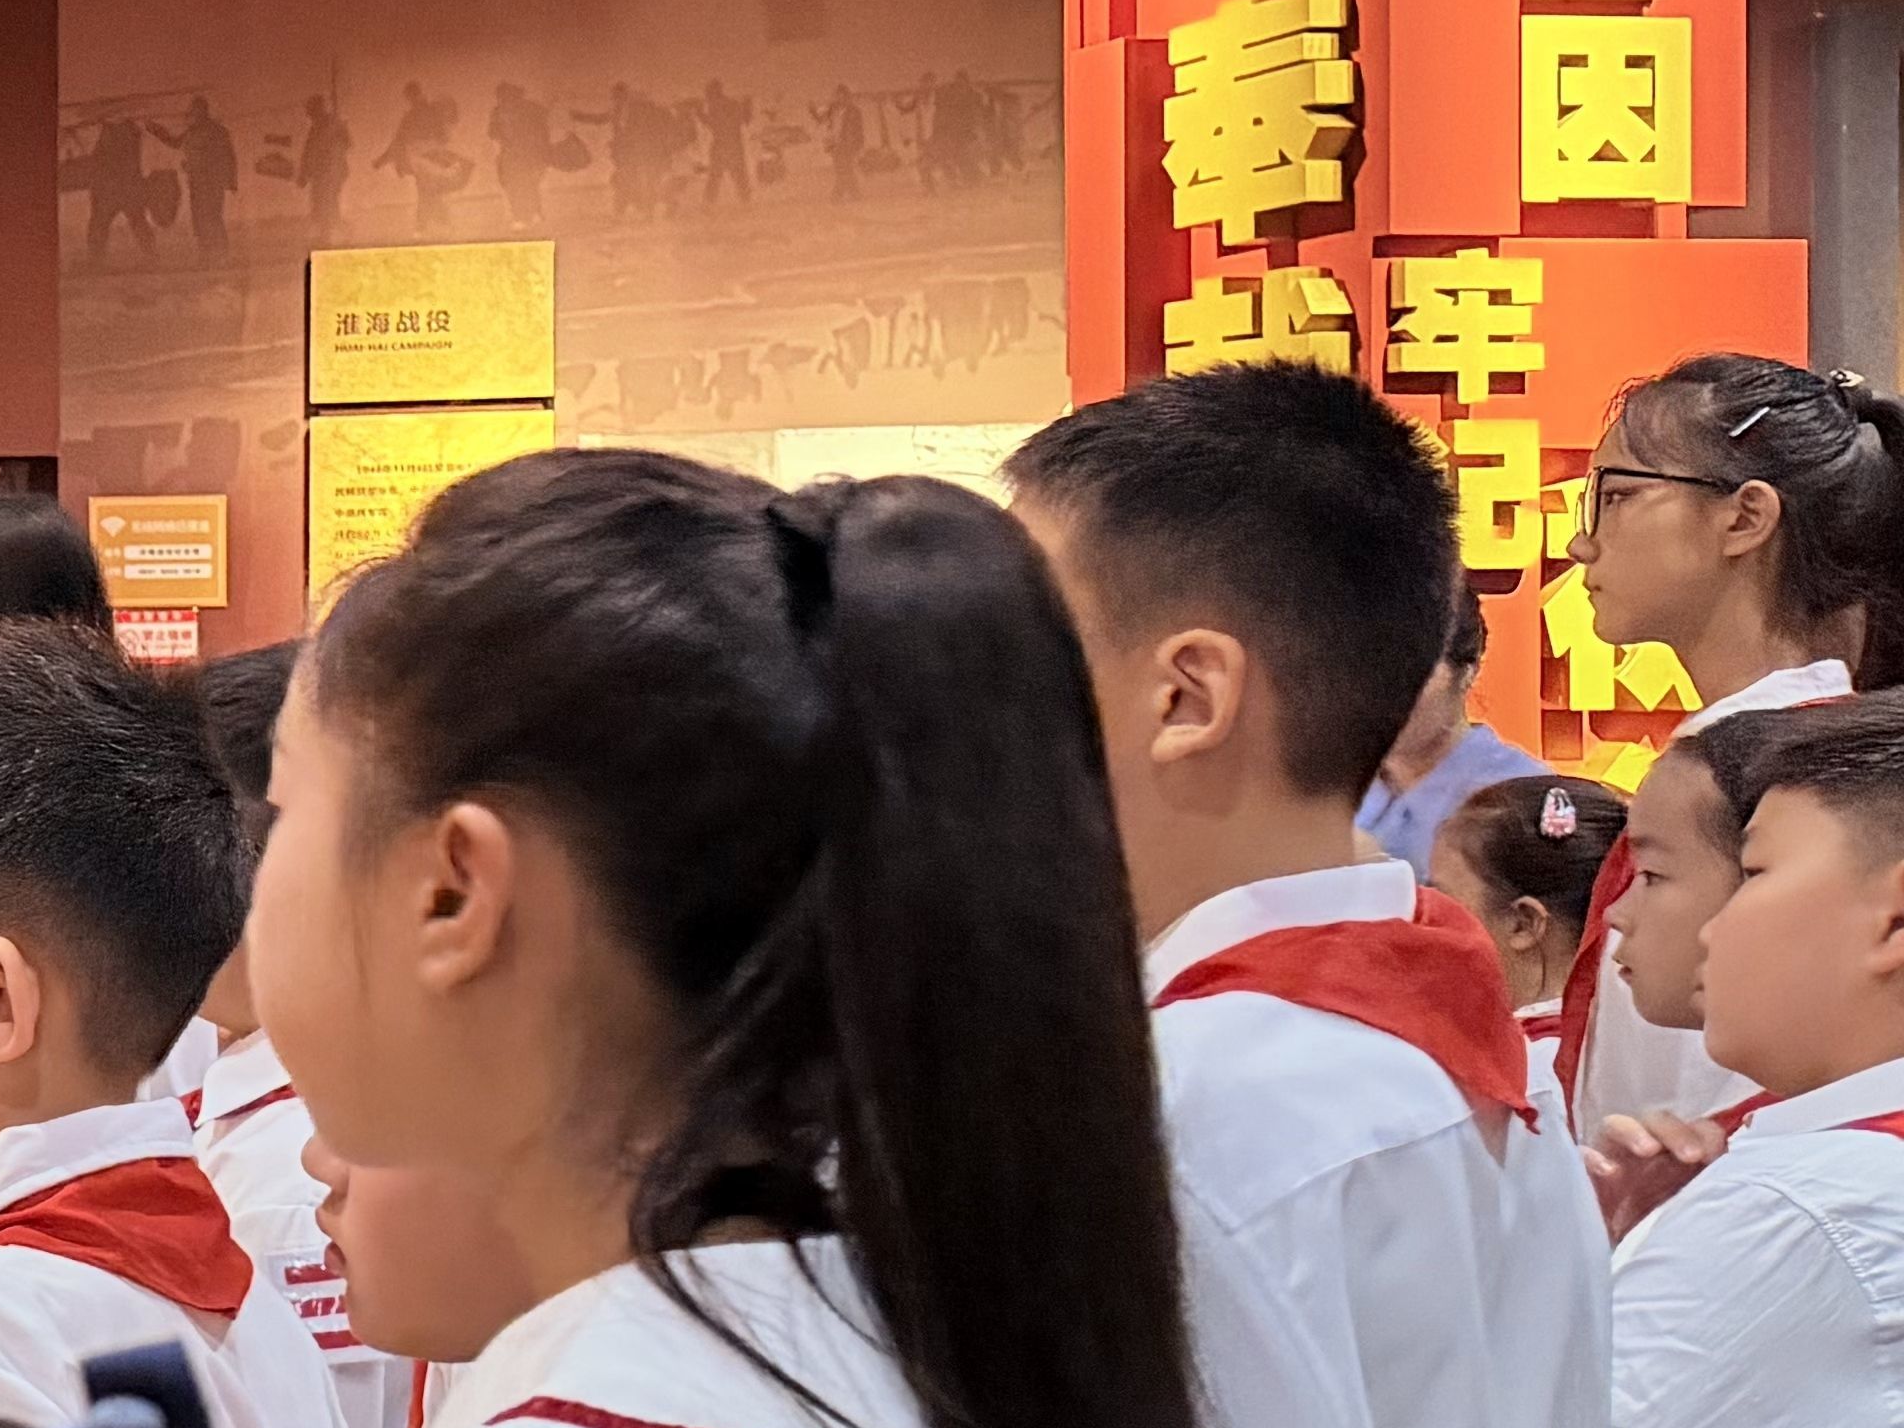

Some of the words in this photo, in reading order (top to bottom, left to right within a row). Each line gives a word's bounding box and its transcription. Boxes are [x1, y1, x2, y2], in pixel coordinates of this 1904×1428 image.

[336, 310, 451, 336] 淮海战役
[392, 340, 452, 351] CAMPAIGN
